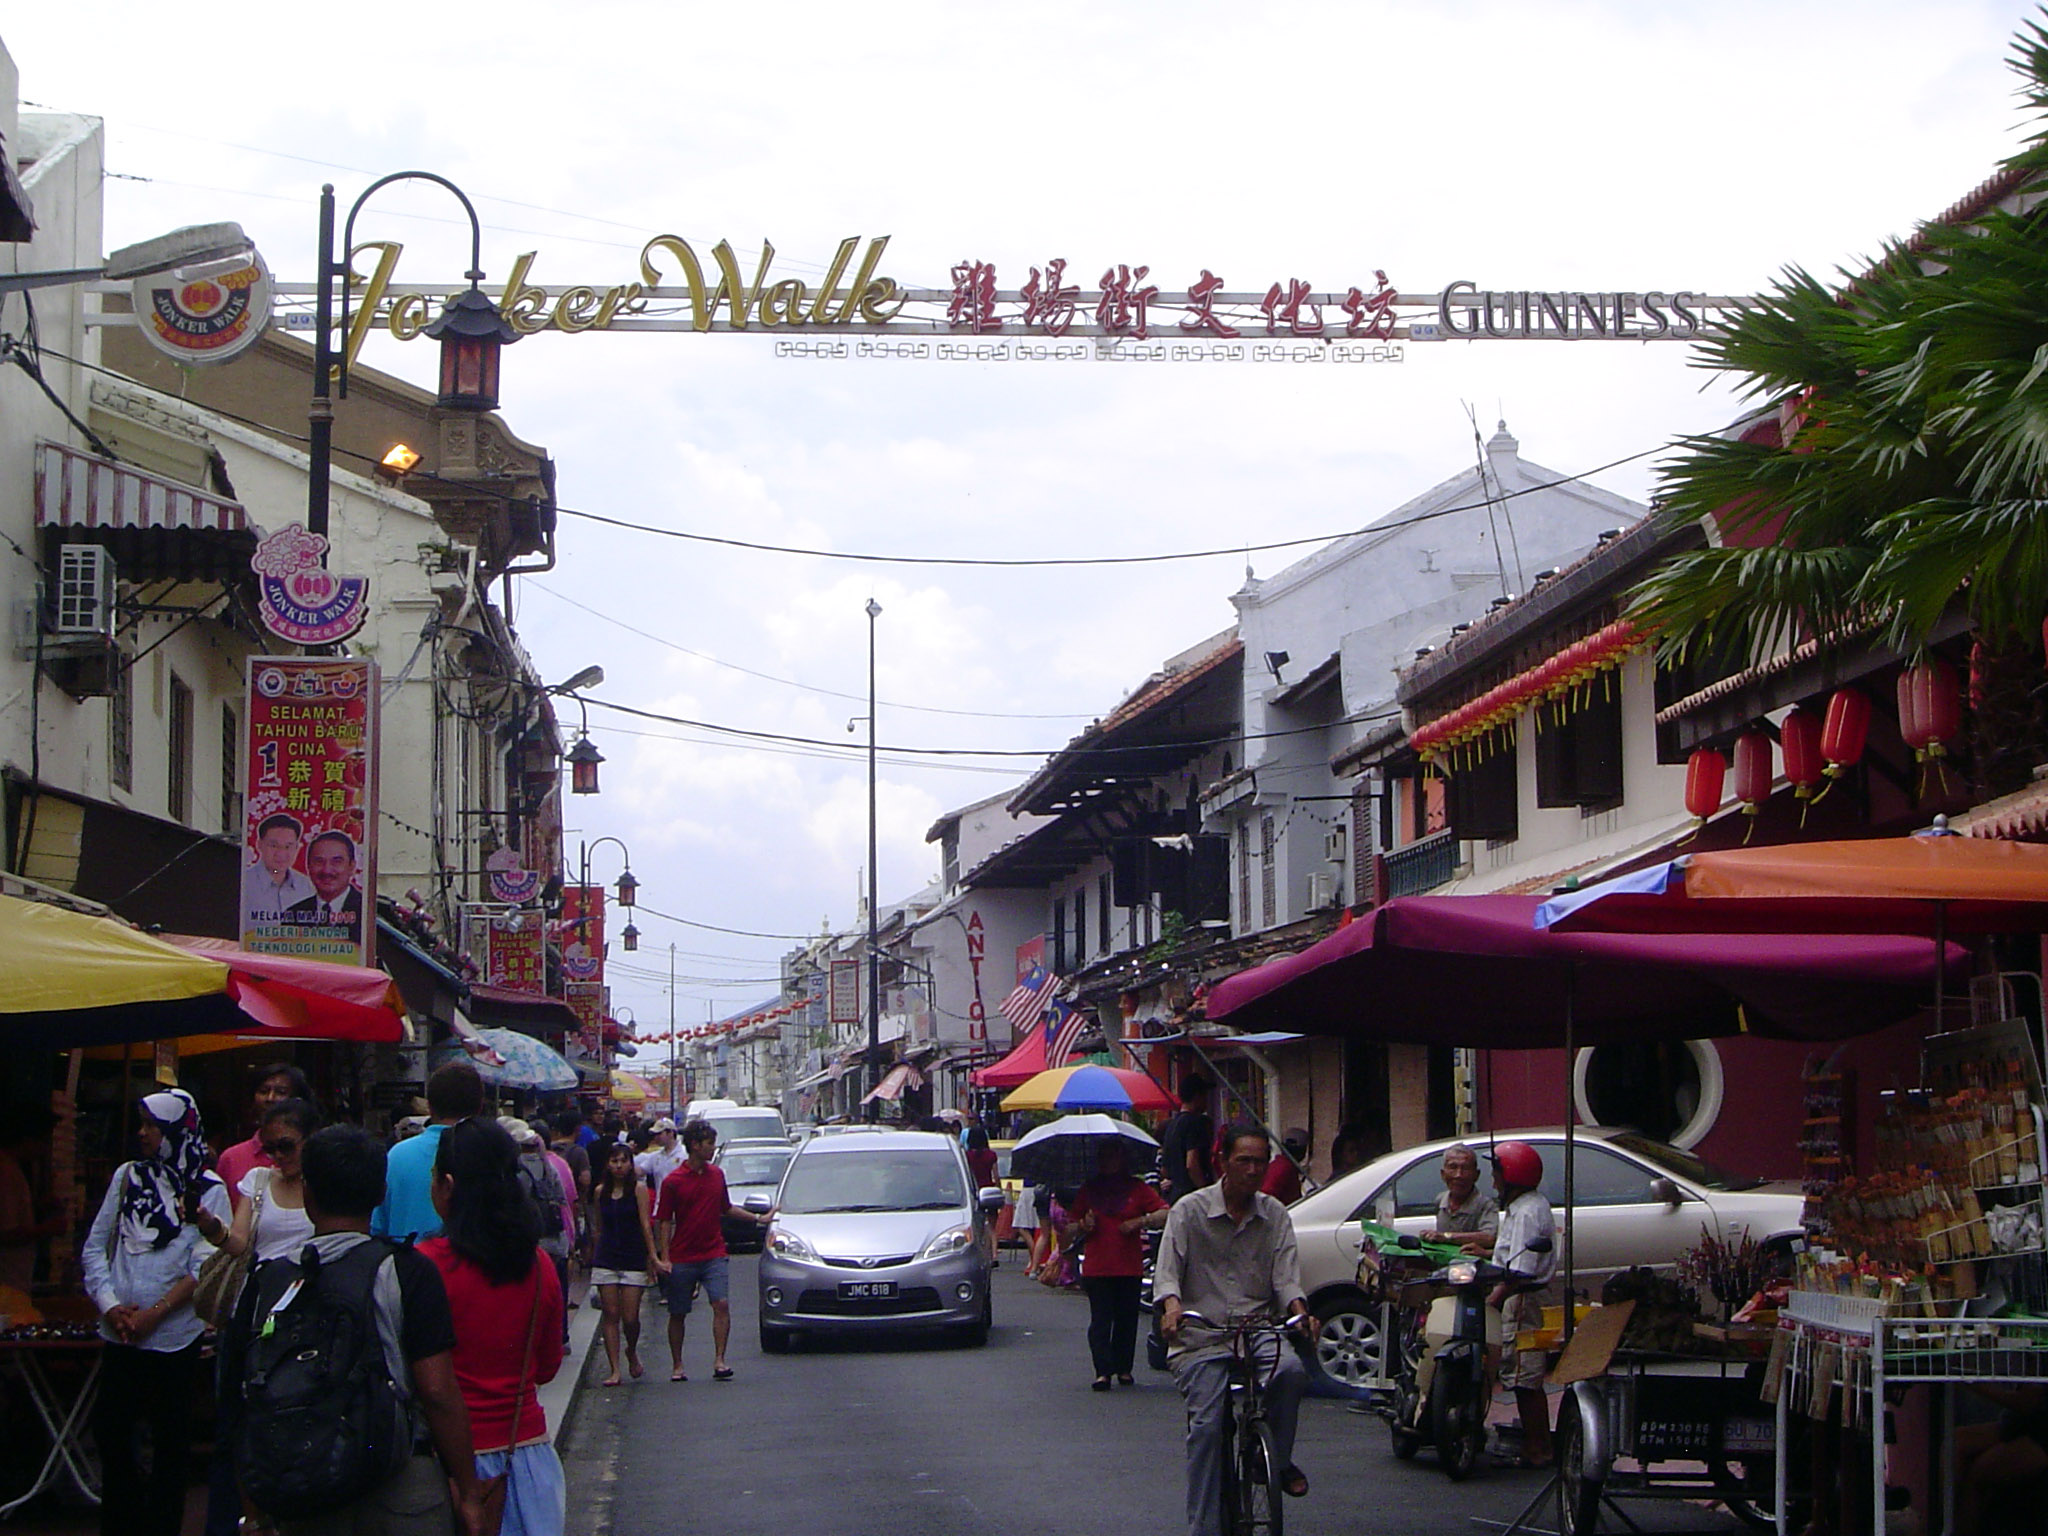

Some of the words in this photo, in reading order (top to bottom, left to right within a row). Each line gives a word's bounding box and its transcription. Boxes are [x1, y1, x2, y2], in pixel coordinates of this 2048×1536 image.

[331, 241, 647, 380] Joker
[640, 233, 909, 334] Walk
[1438, 280, 1699, 340] GUINNESS
[157, 296, 209, 334] JONKER
[212, 295, 246, 329] WALK
[268, 584, 319, 625] JONKER
[322, 586, 356, 621] WALK
[270, 705, 346, 720] SELAMAT
[255, 723, 308, 738] TAHUN
[314, 725, 360, 739] BARU
[287, 742, 327, 756] CINA
[250, 910, 295, 923] MELAKA
[297, 910, 328, 923] MAJU
[255, 926, 299, 938] NEGERI
[303, 926, 350, 938] BANDAR
[249, 941, 316, 954] TEKNOLOGI
[319, 943, 354, 955] HIJAU
[847, 1283, 870, 1296] JMC
[871, 1283, 890, 1296] 618
